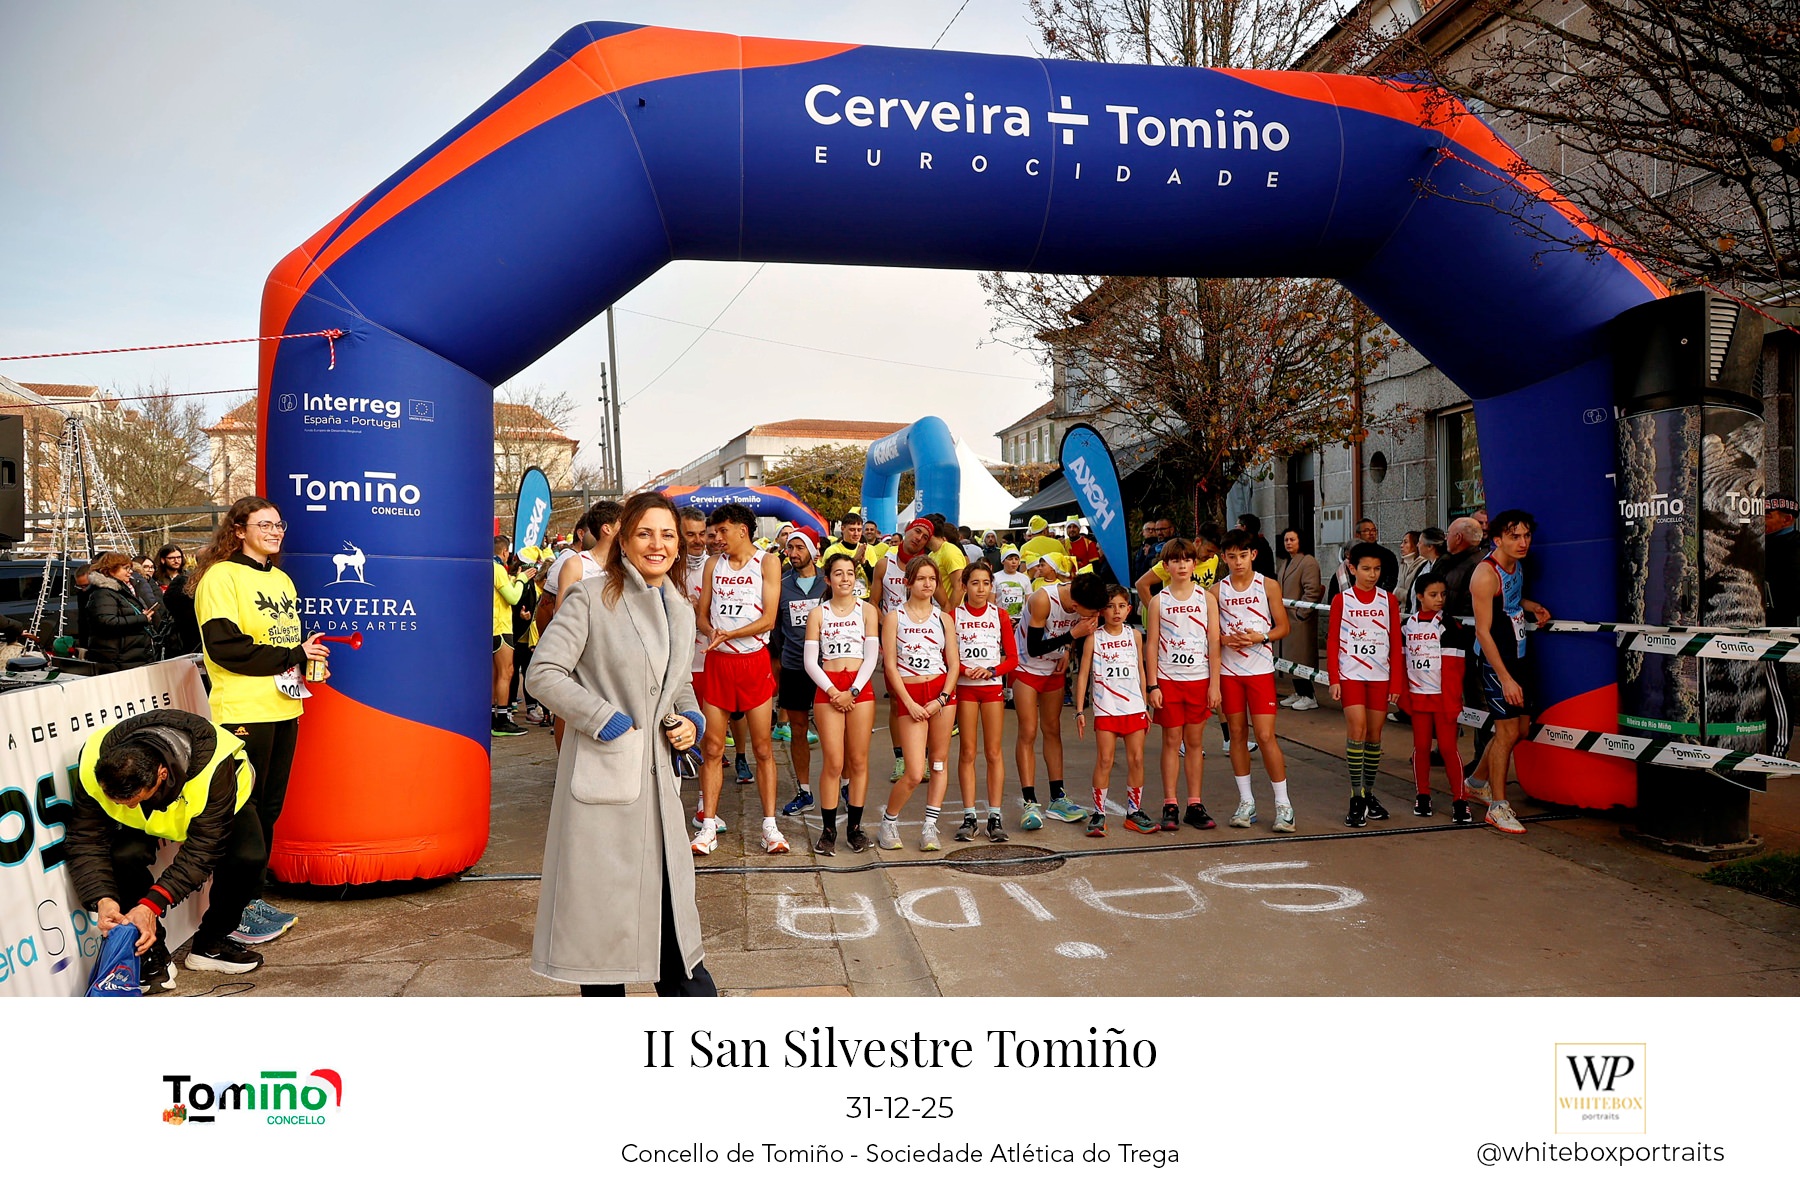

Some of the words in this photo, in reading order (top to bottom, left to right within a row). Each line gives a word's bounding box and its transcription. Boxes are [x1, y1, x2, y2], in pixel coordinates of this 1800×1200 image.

[804, 84, 1031, 137] Cerveira
[1105, 104, 1291, 152] Tomiño
[814, 146, 1280, 189] EUROCIDADE
[303, 393, 401, 419] Interreg
[304, 415, 342, 426] España
[351, 416, 401, 430] Portugal
[732, 495, 761, 503] Tomiño
[371, 506, 421, 517] CONCELLO
[1726, 491, 1766, 524] Tom
[523, 497, 547, 547] OKA
[715, 576, 753, 585] TREGA
[295, 597, 417, 616] CERVEIRA
[1225, 596, 1260, 606] TREGA
[720, 604, 743, 615] 217
[1165, 605, 1202, 615] TREGA
[1349, 609, 1385, 617] TREGA
[795, 615, 808, 625] 59
[828, 620, 857, 628] TREGA
[960, 621, 995, 630] TREGA
[1053, 619, 1080, 629] TREG
[328, 621, 359, 631] DAS
[366, 621, 417, 631] ARTES
[1407, 632, 1437, 641] TREGA
[828, 643, 851, 654] 212
[1100, 640, 1133, 651] TREGA
[1353, 644, 1376, 655] 163
[964, 647, 988, 658] 200
[908, 656, 931, 669] 232
[1171, 653, 1195, 664] 206
[1411, 659, 1431, 669] 164
[1106, 667, 1130, 677] 210
[31, 722, 58, 743] DE
[70, 692, 172, 732] DEPORTES
[1641, 719, 1647, 727] do
